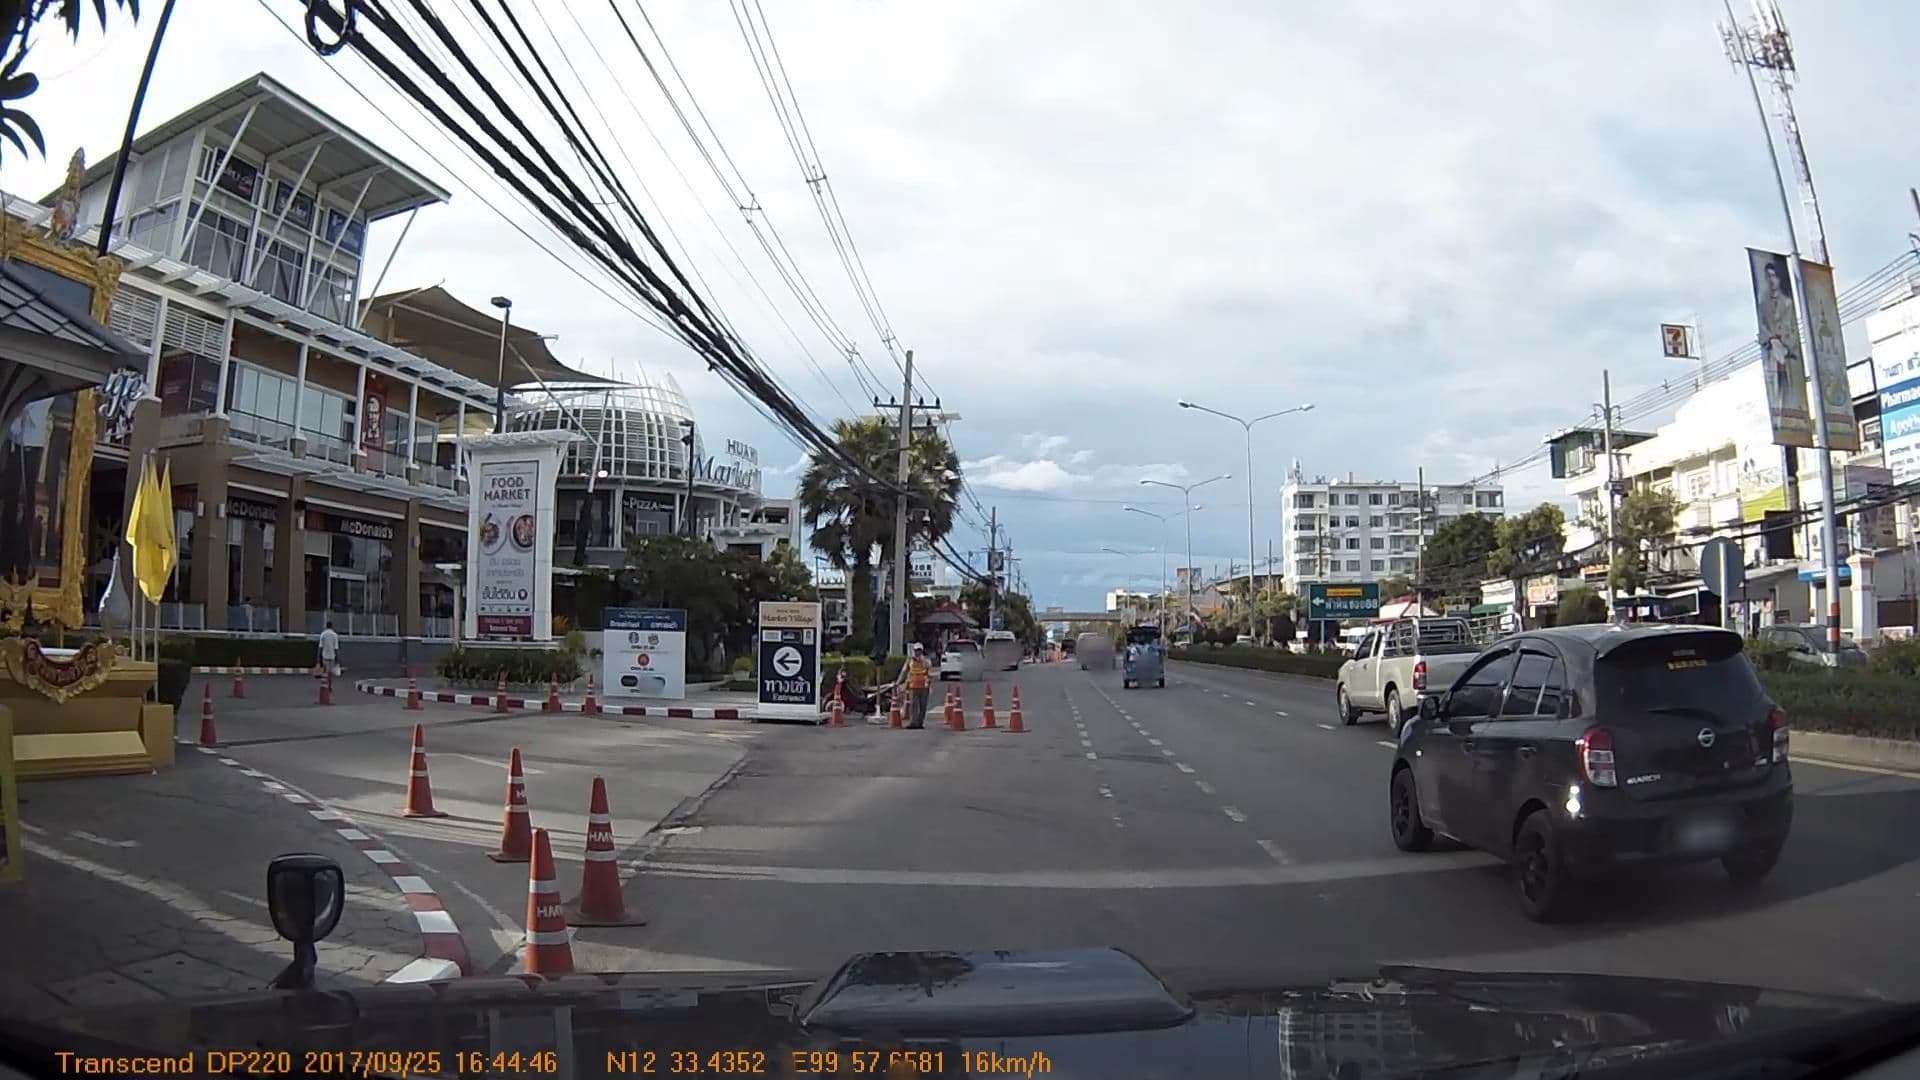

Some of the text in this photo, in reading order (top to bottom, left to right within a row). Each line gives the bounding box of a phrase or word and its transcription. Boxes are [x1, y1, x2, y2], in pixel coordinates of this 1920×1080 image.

[491, 477, 524, 489] FOOD
[484, 489, 531, 501] MARKET
[629, 496, 658, 511] PIZZA
[341, 519, 393, 540] McDonald's
[764, 675, 811, 694] ทางเข้า
[773, 693, 806, 702] Entrance
